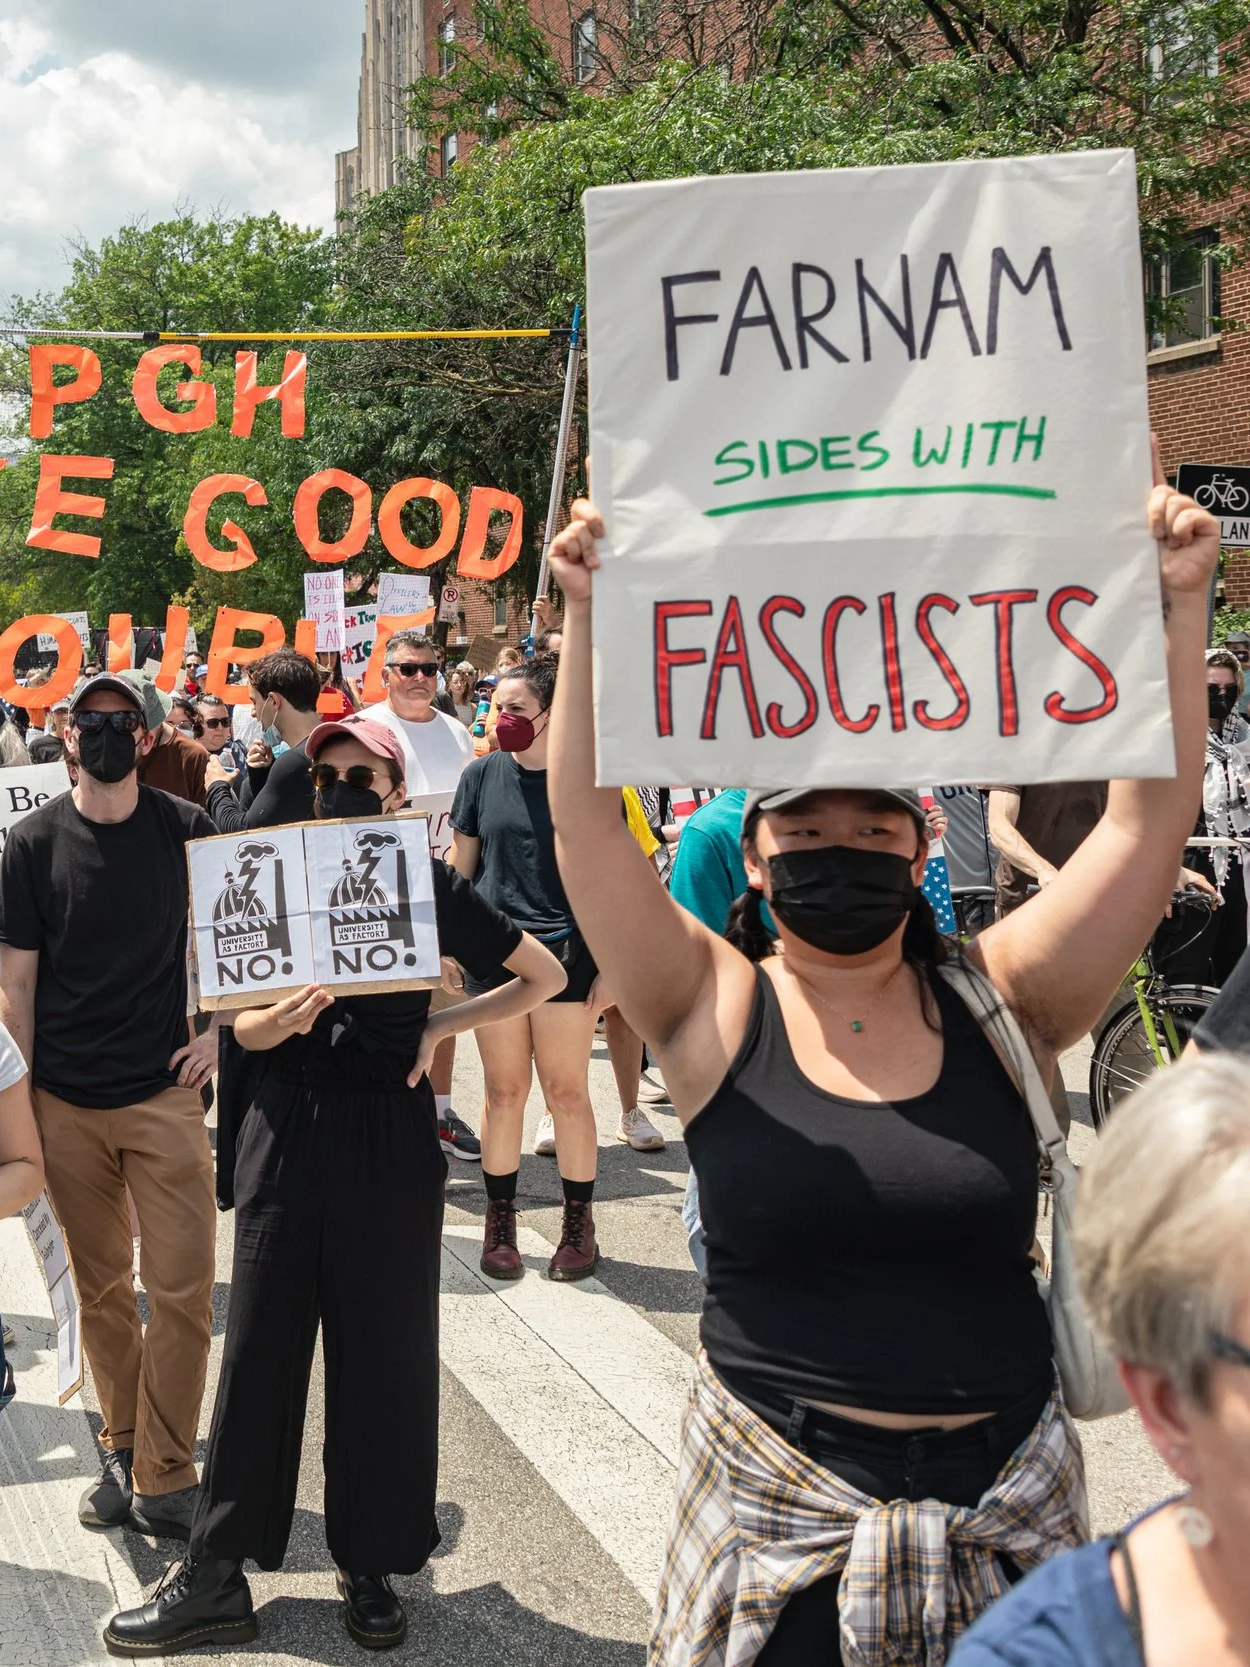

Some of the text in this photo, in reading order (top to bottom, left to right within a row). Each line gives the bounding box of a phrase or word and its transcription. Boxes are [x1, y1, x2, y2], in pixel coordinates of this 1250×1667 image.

[661, 246, 1072, 381] FARNAM
[29, 344, 307, 439] PGH
[714, 416, 1047, 485] SIDES WITH
[183, 468, 524, 580] GOOD
[1221, 521, 1250, 540] LAN
[654, 585, 1117, 740] FASCISTS
[6, 786, 50, 812] Be
[221, 933, 264, 946] UNIVERSITY
[338, 923, 385, 934] UNIVERSITY
[352, 930, 385, 940] FACTORY
[234, 940, 265, 951] FACTORY
